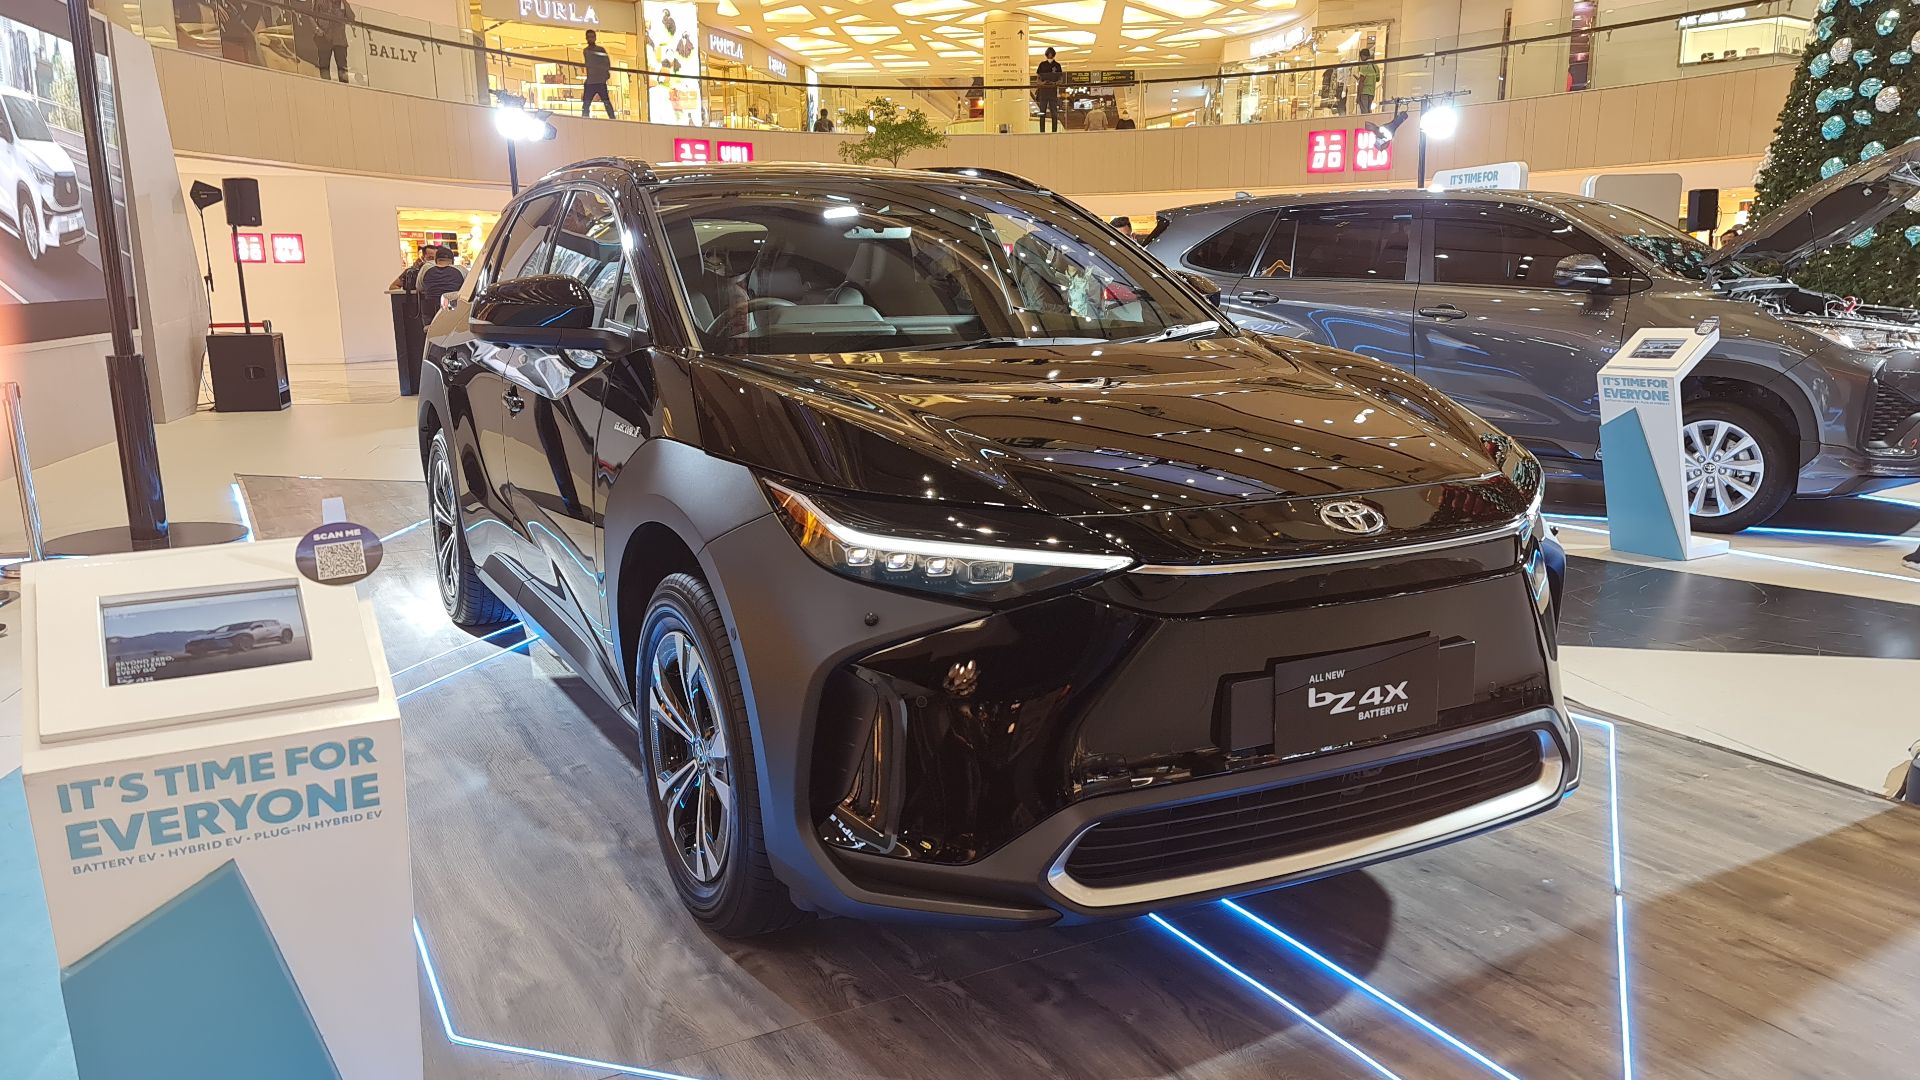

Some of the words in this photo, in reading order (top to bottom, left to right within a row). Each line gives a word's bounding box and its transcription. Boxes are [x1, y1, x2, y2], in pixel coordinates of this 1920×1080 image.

[520, 0, 599, 24] FURLA
[369, 43, 417, 63] BALLY
[1450, 174, 1463, 185] IT'S
[1464, 172, 1480, 184] TIME
[1482, 170, 1499, 182] FOR
[1603, 376, 1620, 386] IT'S
[1621, 377, 1647, 388] TIME
[1647, 378, 1668, 389] FOR
[1603, 387, 1670, 402] EVERYONE
[313, 530, 344, 541] SCAN
[344, 528, 362, 537] ME
[1309, 673, 1325, 684] ALL
[1325, 669, 1346, 681] NEW
[1358, 704, 1396, 720] BATTERY
[1397, 702, 1409, 713] EV
[56, 772, 149, 814] IT'S
[154, 751, 276, 796] TIME
[285, 736, 378, 777] FOR
[65, 772, 380, 861] EVERYONE
[72, 856, 135, 875] BATTERY
[138, 851, 157, 864] EV
[168, 840, 223, 858] HYBRID
[225, 835, 243, 847] EV
[254, 822, 311, 841] PLUG-IN
[314, 813, 364, 830] HYBRID
[366, 809, 383, 821] EV
